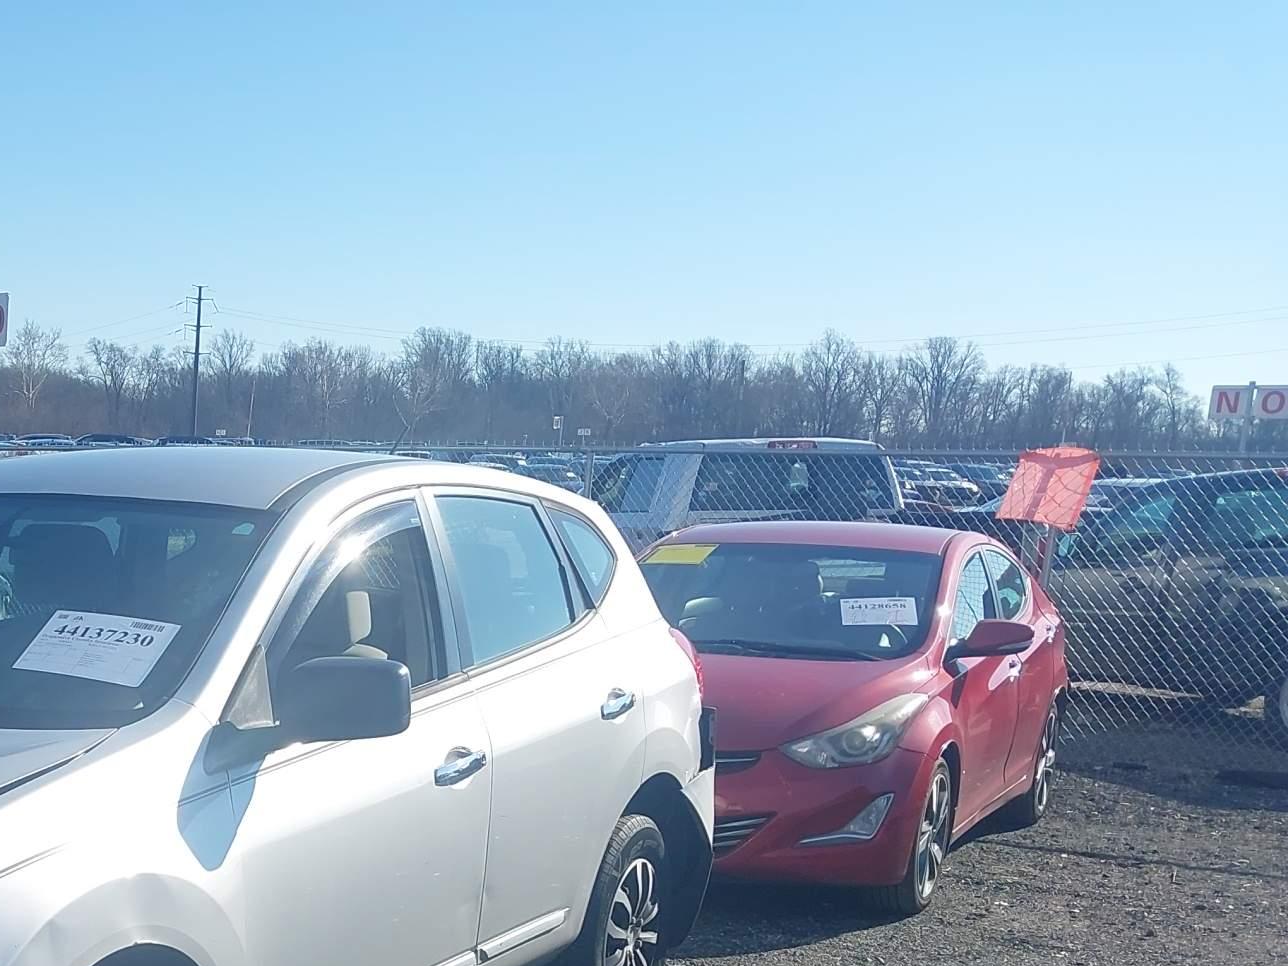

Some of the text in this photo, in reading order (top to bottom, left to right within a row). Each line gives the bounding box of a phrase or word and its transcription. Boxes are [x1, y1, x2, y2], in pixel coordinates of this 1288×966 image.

[1215, 390, 1286, 414] N O
[53, 623, 155, 648] 44137230
